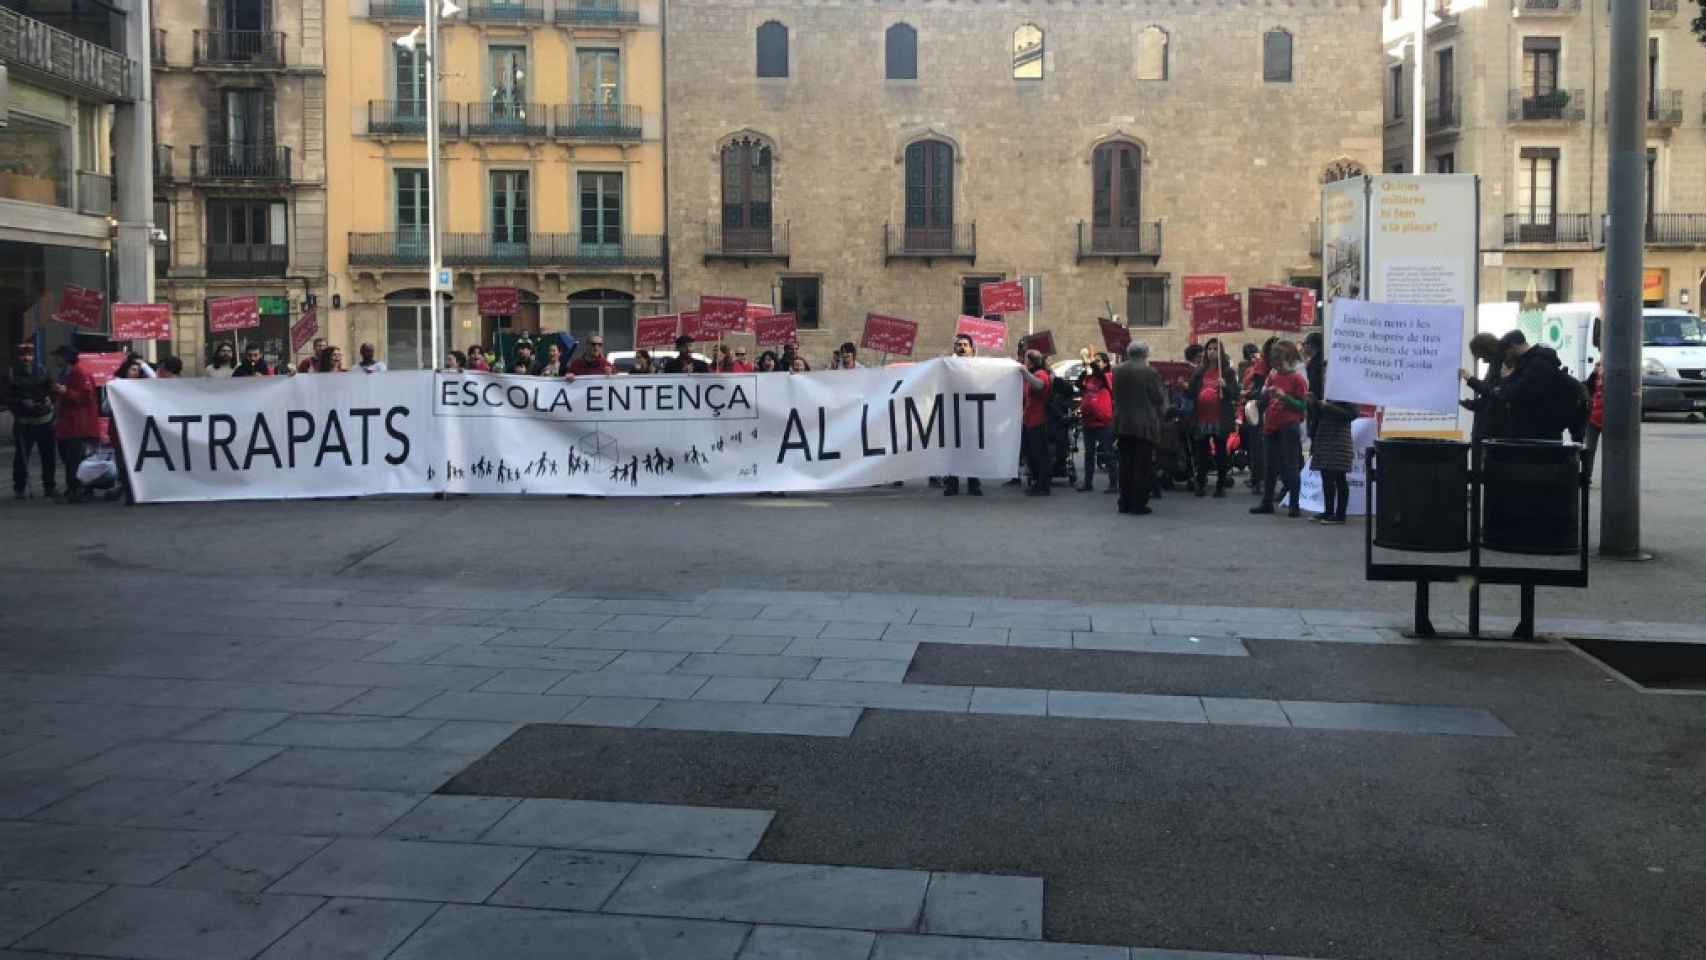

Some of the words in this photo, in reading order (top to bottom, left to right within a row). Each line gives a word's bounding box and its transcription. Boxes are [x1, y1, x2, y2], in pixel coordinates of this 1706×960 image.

[441, 380, 573, 413] ESCOLA
[586, 384, 751, 416] ENTENÇA
[777, 406, 841, 464] AL
[861, 380, 997, 457] LÍMIT
[134, 406, 411, 473] ATRAPATS
